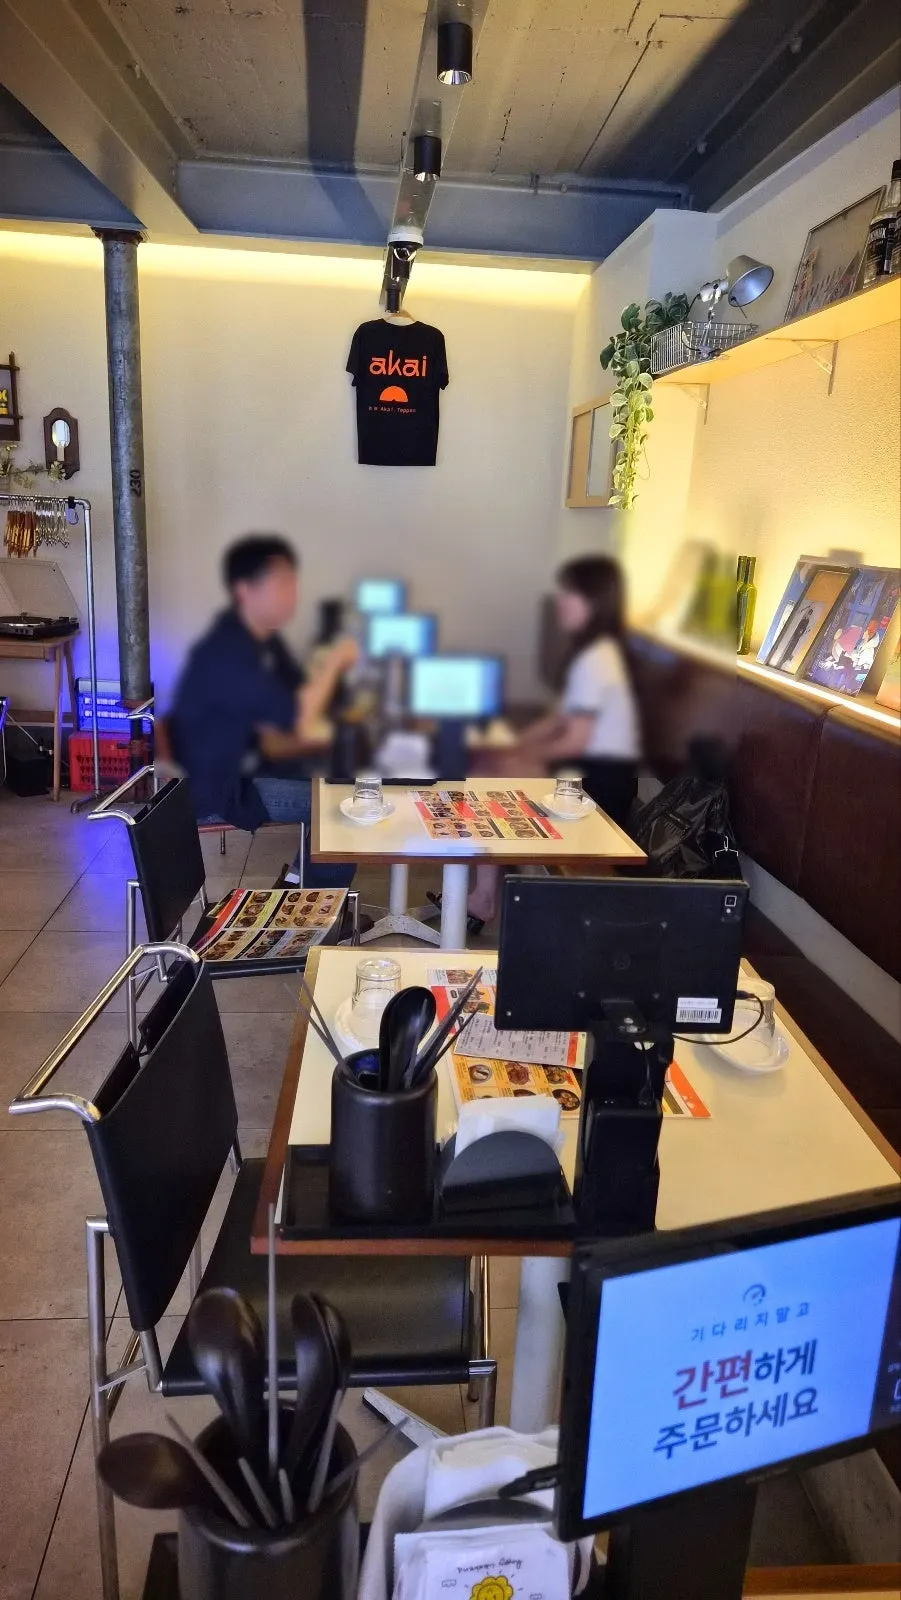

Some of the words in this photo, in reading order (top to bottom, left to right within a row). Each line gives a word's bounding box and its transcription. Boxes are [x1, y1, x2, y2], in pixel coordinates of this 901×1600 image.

[369, 349, 427, 377] akai
[129, 469, 142, 498] 230
[673, 1338, 818, 1411] 간편하게
[652, 1387, 819, 1460] 주문하세요
